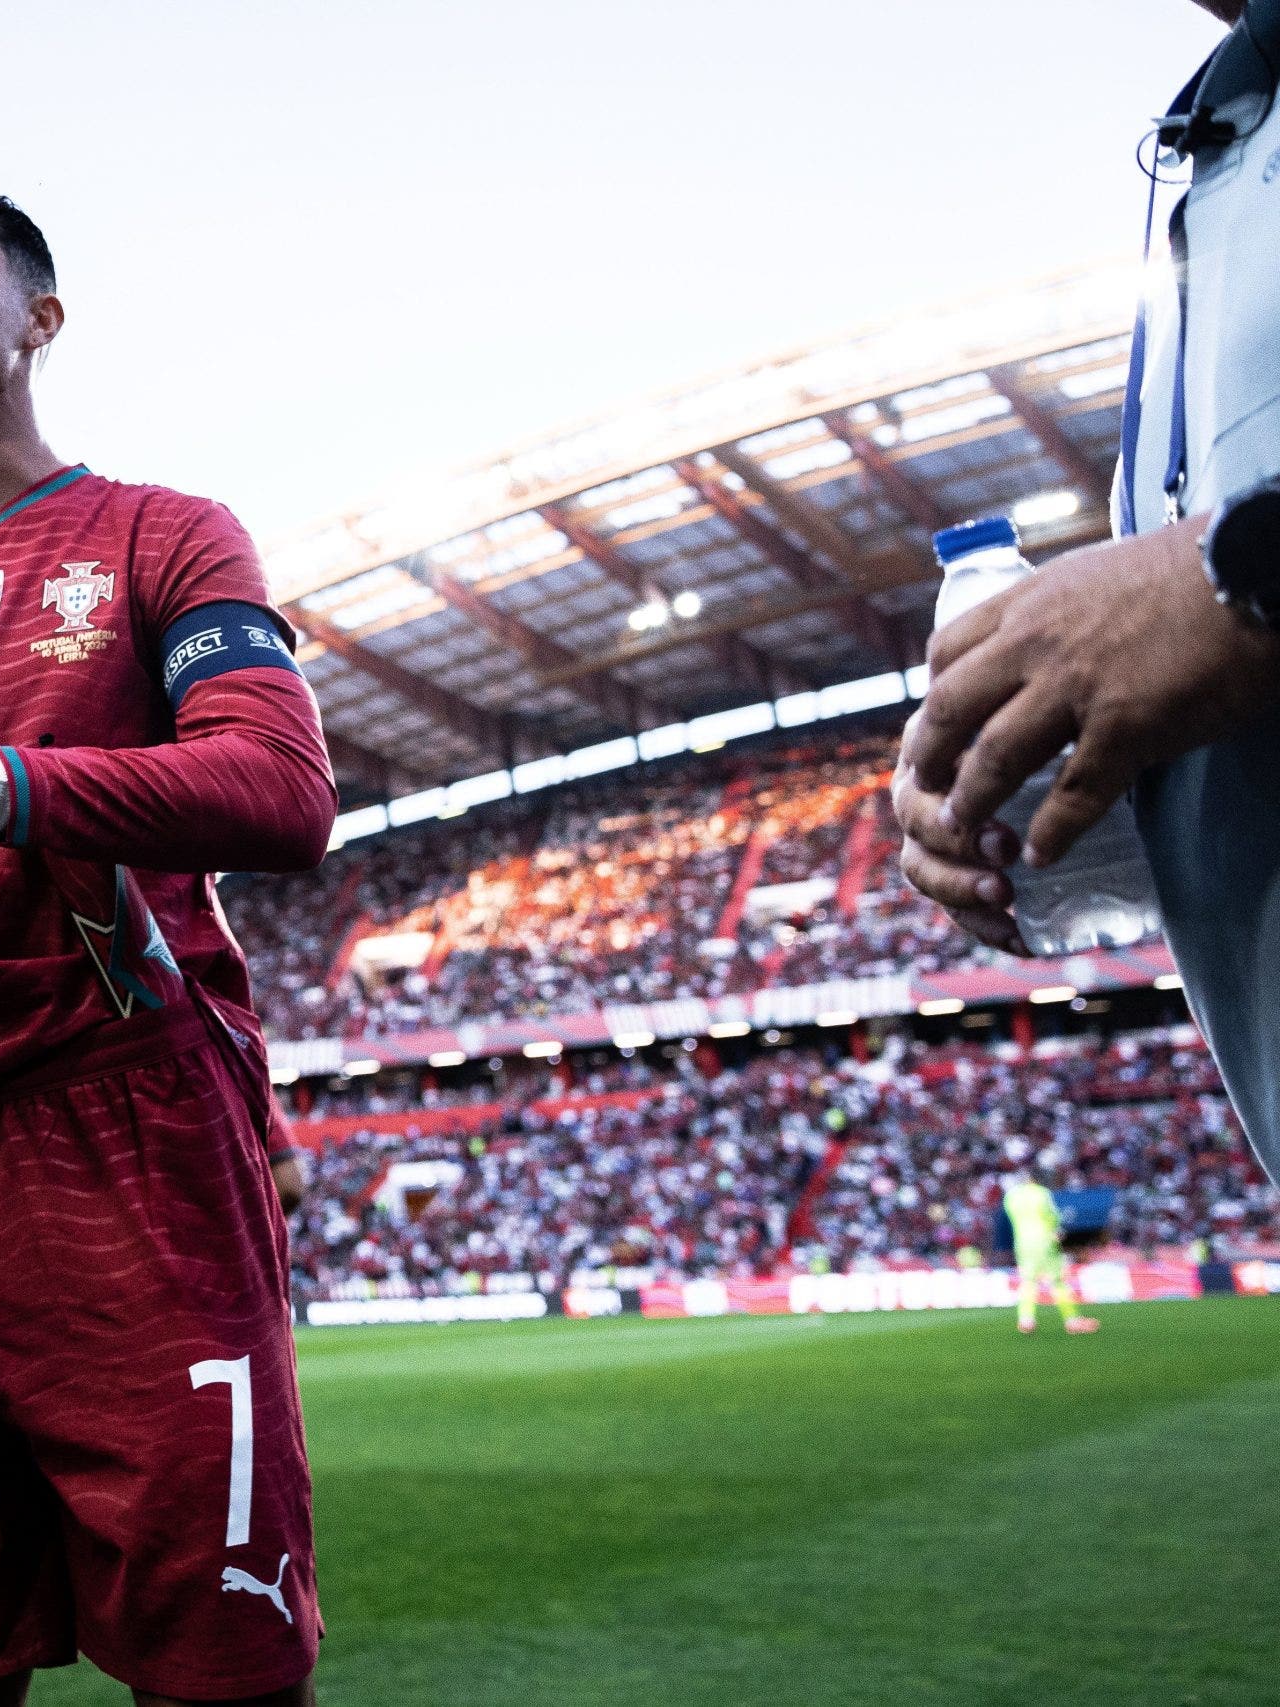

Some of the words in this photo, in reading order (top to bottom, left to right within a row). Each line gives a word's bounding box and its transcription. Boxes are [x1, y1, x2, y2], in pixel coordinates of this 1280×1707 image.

[58, 651, 89, 664] LEIRIA
[165, 632, 223, 688] ESPECT
[188, 1354, 253, 1547] 7
